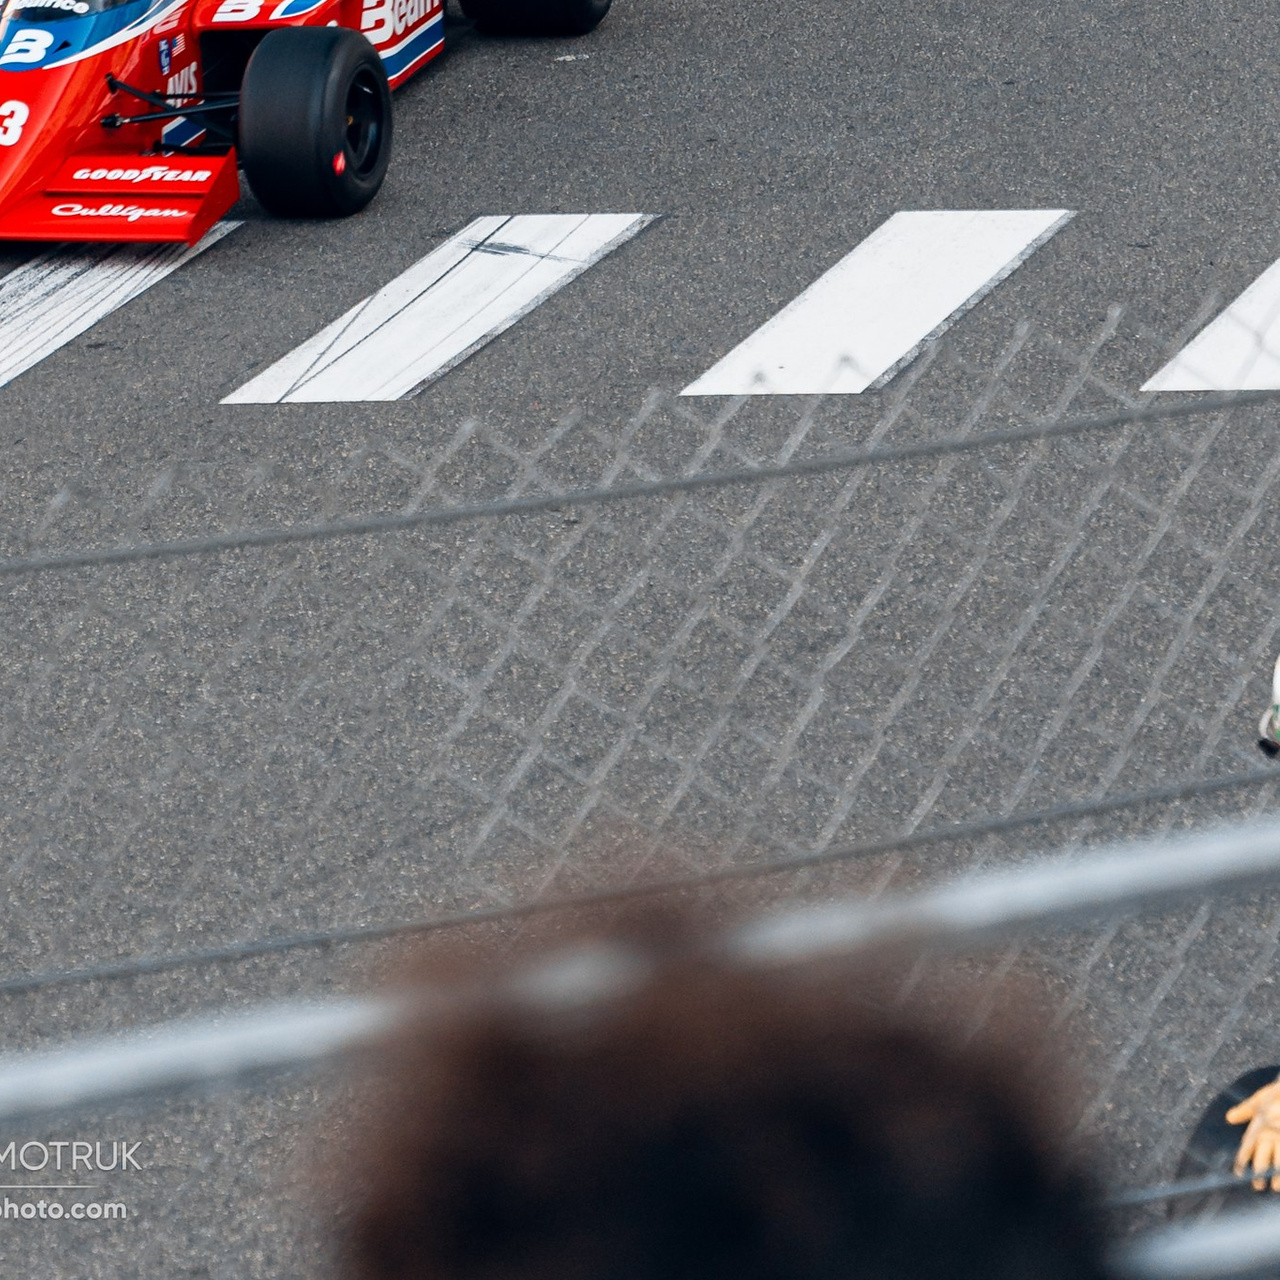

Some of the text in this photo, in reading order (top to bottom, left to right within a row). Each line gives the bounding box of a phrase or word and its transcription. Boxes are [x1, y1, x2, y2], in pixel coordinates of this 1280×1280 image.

[166, 61, 198, 109] AVIS
[73, 165, 211, 183] GOODYEAR
[51, 202, 187, 222] Culligan
